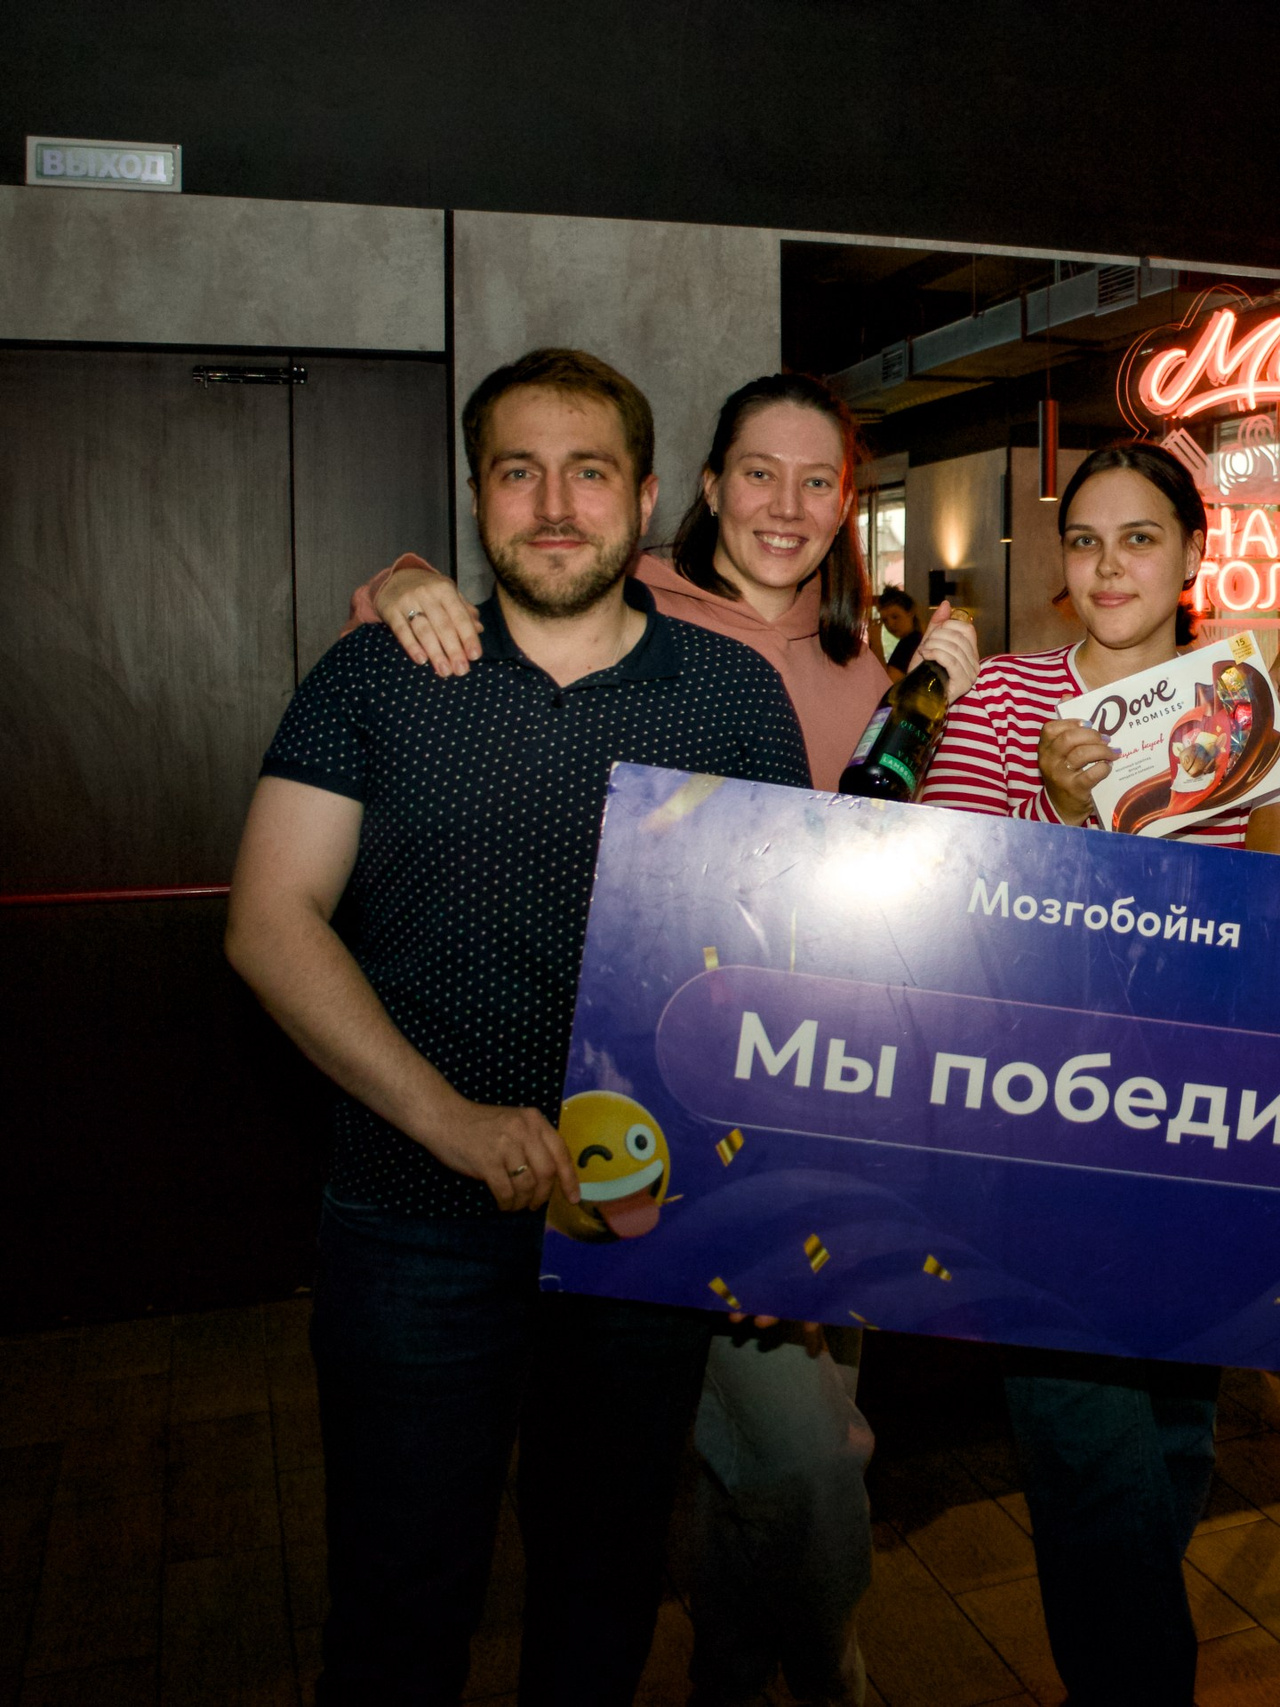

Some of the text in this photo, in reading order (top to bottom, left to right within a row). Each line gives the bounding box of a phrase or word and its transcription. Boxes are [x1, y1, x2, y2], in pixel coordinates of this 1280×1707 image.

[42, 149, 167, 182] ВЫХОД
[1235, 637, 1246, 647] 15
[1089, 679, 1177, 737] Dove
[1128, 702, 1184, 729] PROMISES
[967, 878, 1242, 949] Мозгобойня
[733, 1010, 896, 1098] Мы
